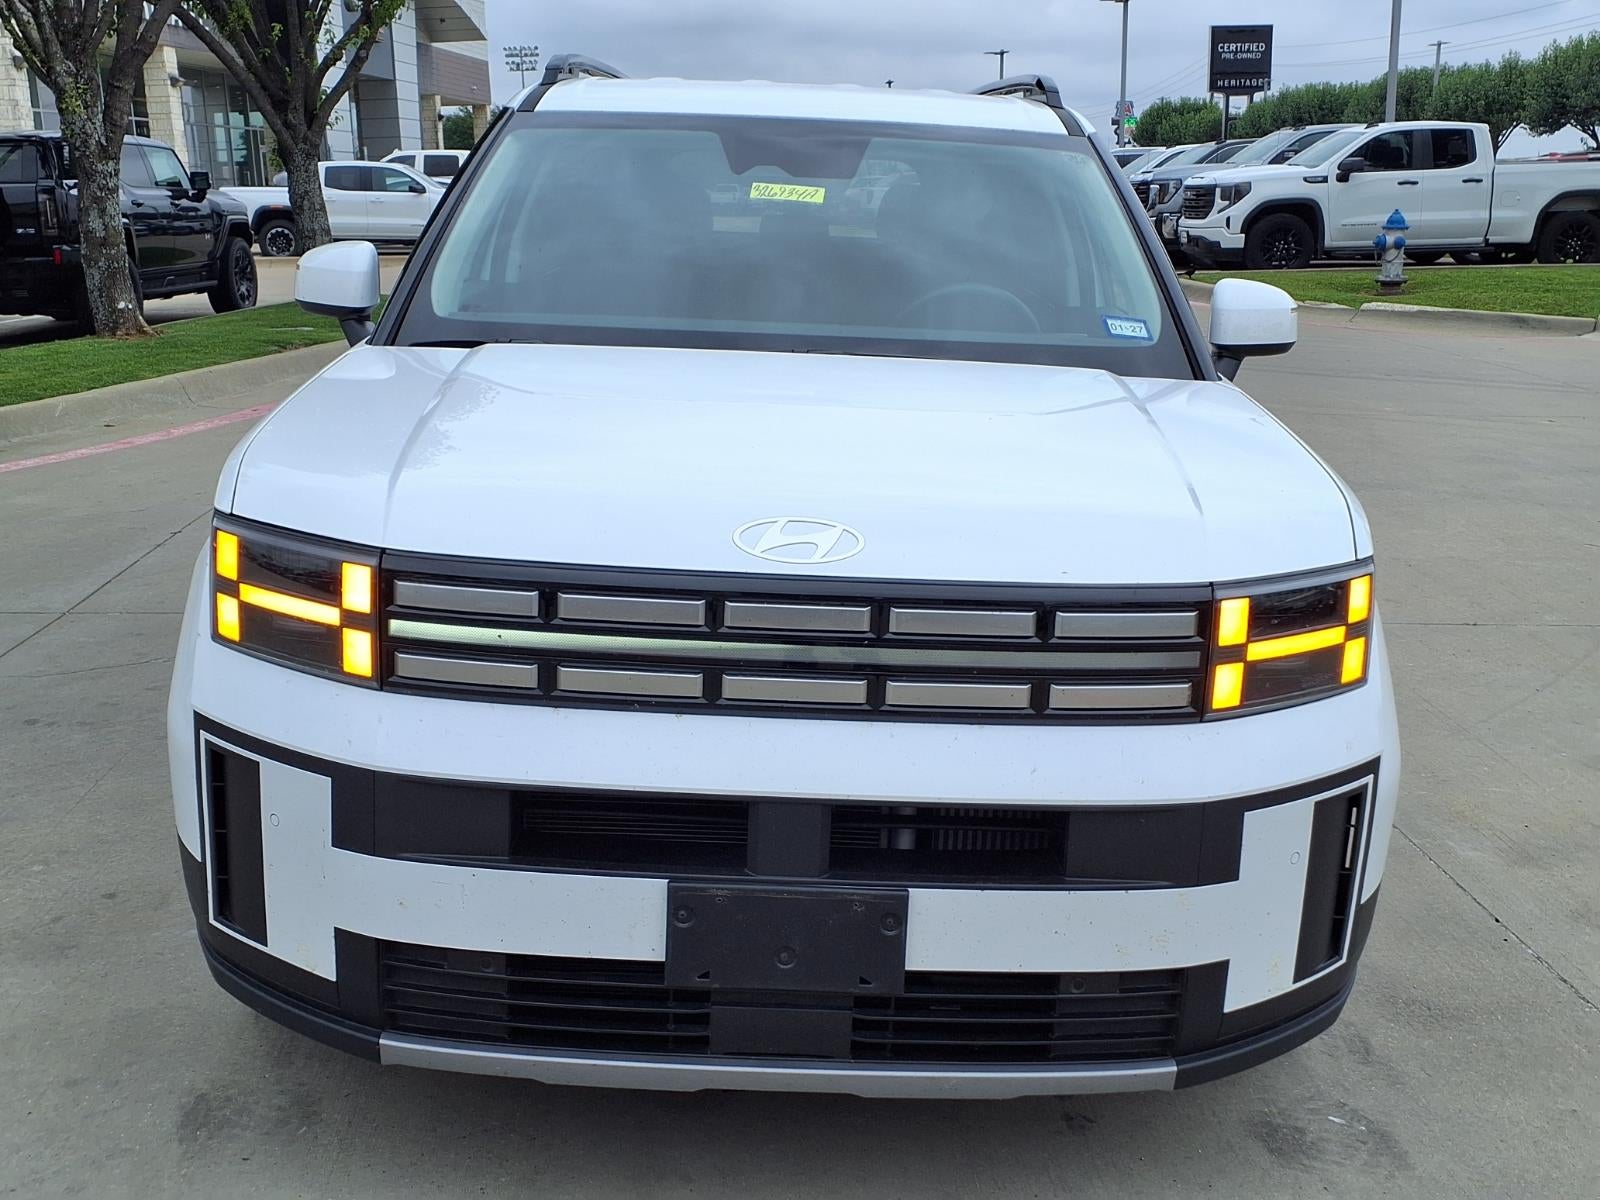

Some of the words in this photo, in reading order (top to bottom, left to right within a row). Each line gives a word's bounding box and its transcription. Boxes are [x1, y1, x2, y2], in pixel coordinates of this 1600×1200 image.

[1218, 43, 1266, 52] CERTIFIED
[1221, 52, 1262, 60] PRE-OWNED
[1217, 78, 1264, 87] HERITAGE
